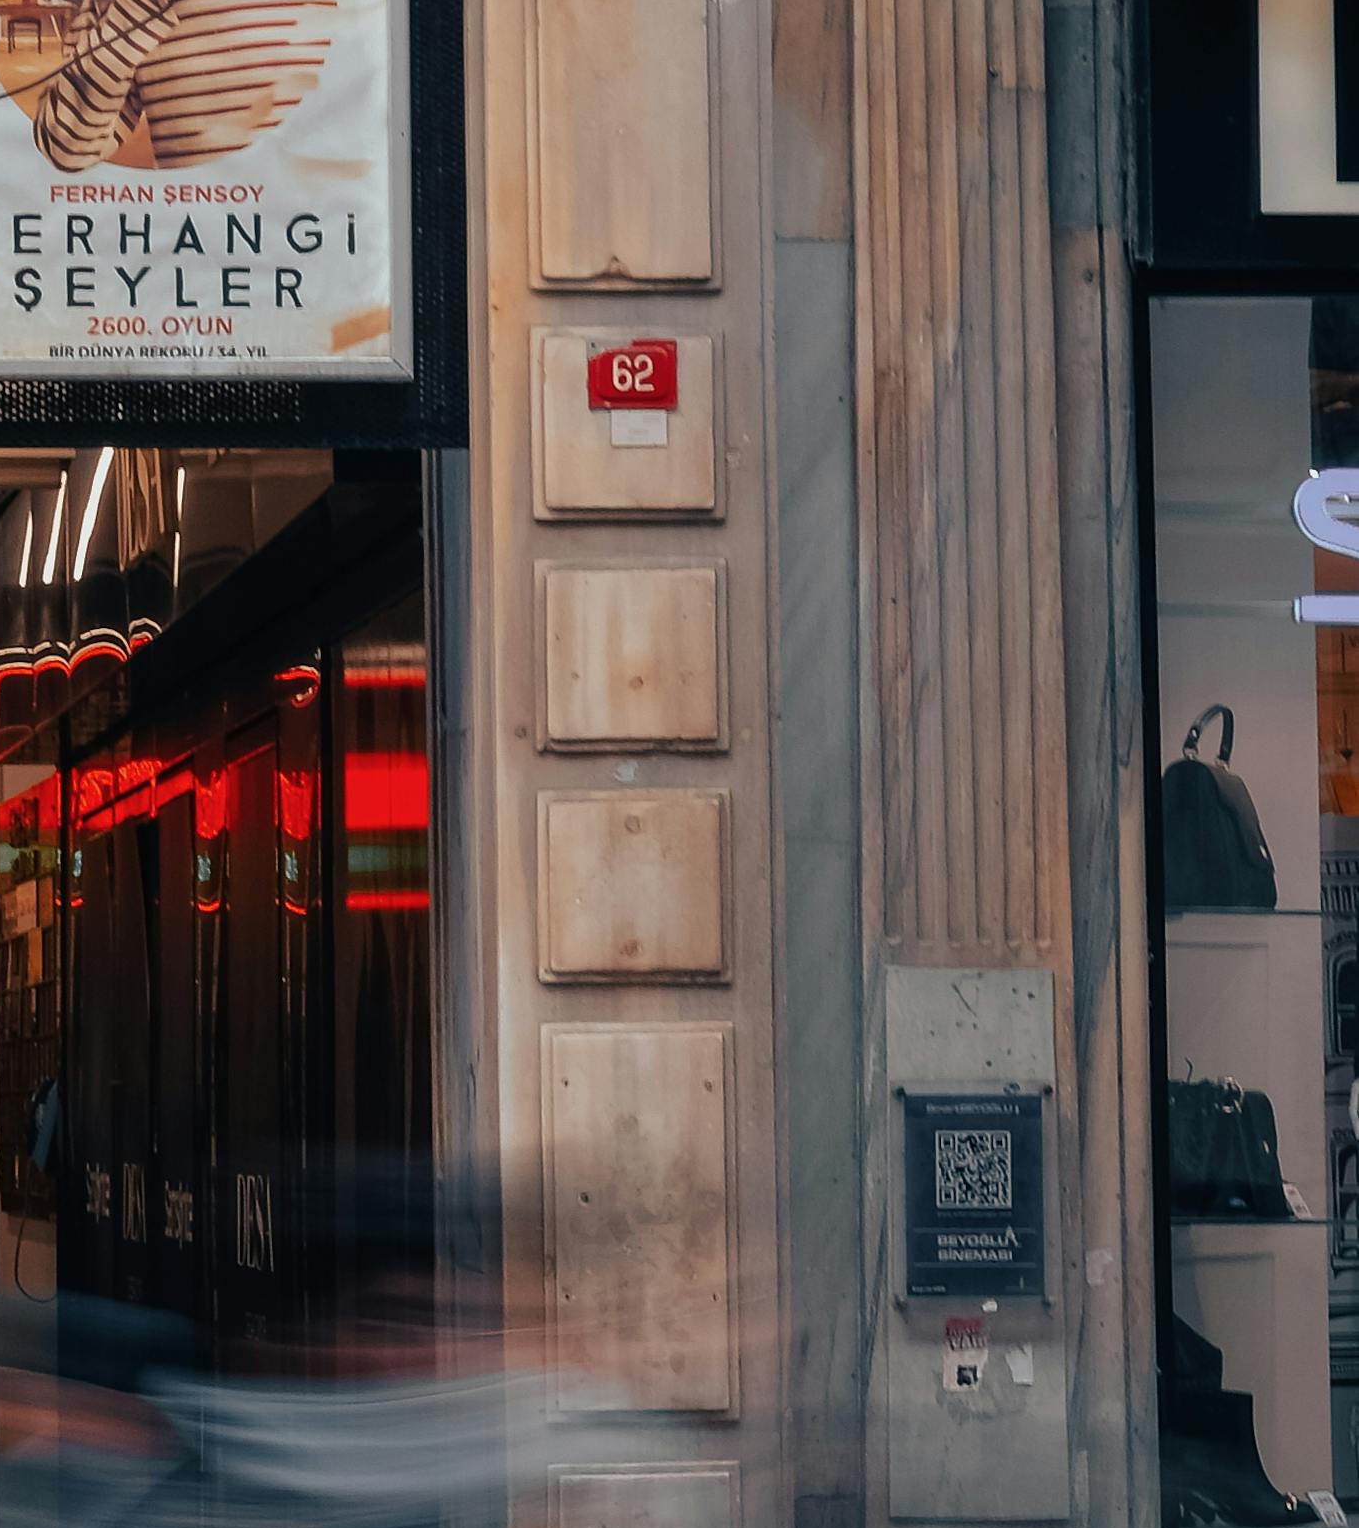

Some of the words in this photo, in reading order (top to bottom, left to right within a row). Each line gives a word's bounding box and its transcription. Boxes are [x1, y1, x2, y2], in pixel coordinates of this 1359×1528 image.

[50, 184, 154, 204] FERHAN
[162, 184, 265, 207] ŞENSOY
[13, 266, 305, 312] ŞEYLER
[86, 316, 153, 336] 2600.
[162, 316, 234, 336] OYUN
[612, 353, 656, 393] 62
